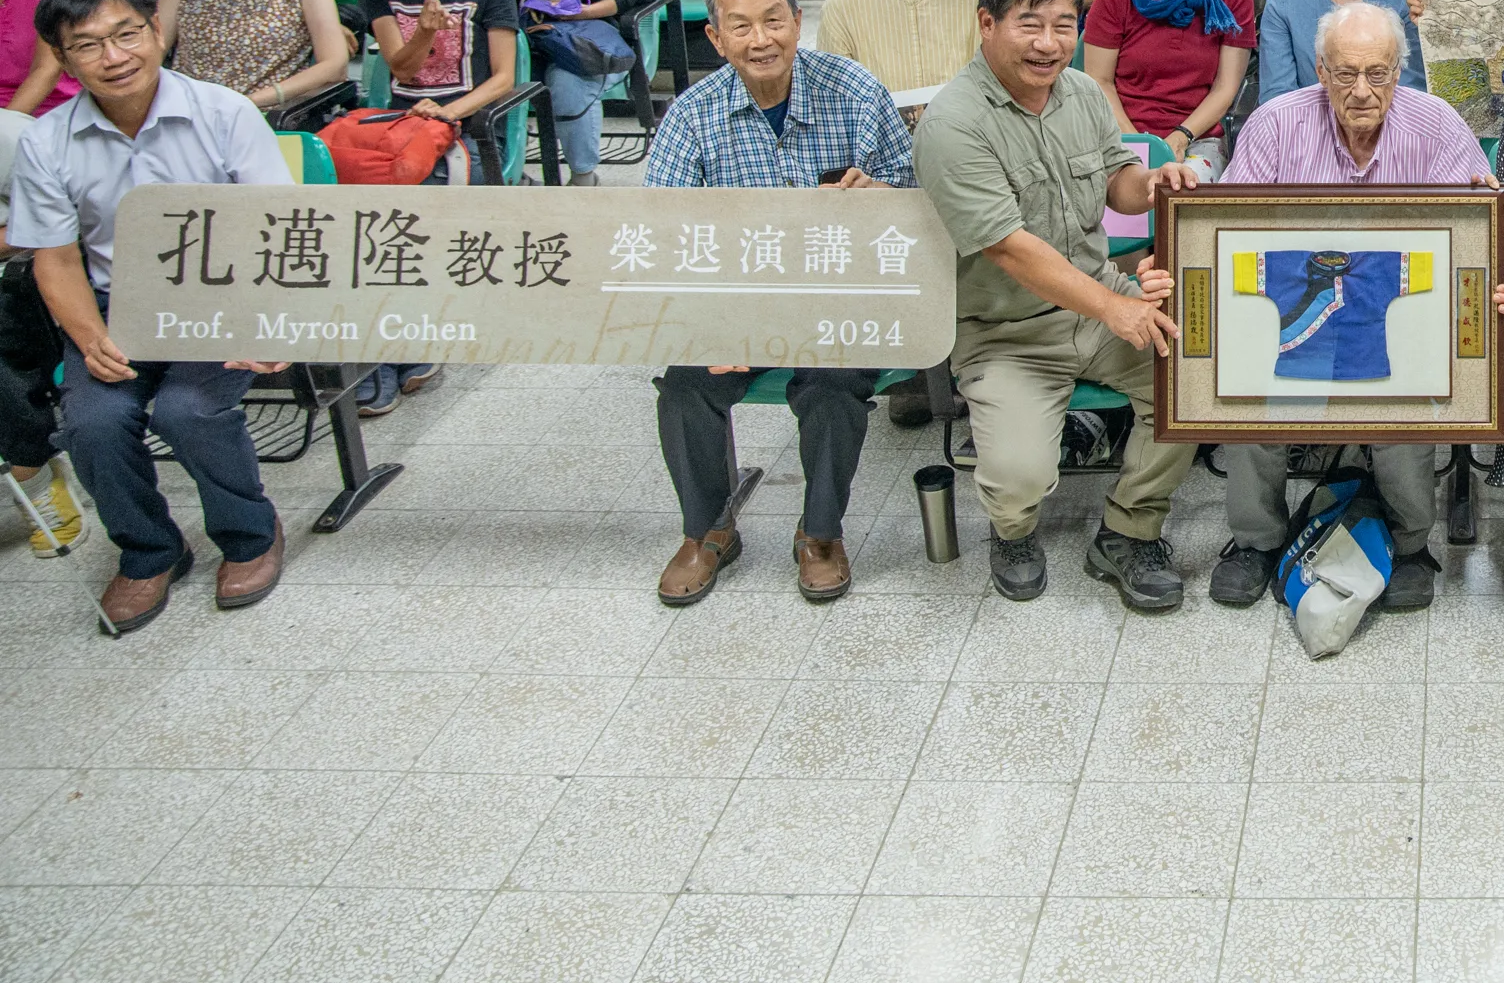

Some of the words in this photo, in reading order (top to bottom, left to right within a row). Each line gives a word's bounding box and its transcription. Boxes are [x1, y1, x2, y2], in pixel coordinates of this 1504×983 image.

[609, 223, 918, 275] 榮退演講會
[155, 311, 234, 340] Prof.
[255, 313, 359, 345] Myron
[378, 313, 477, 342] Cohen
[816, 319, 905, 347] 2024
